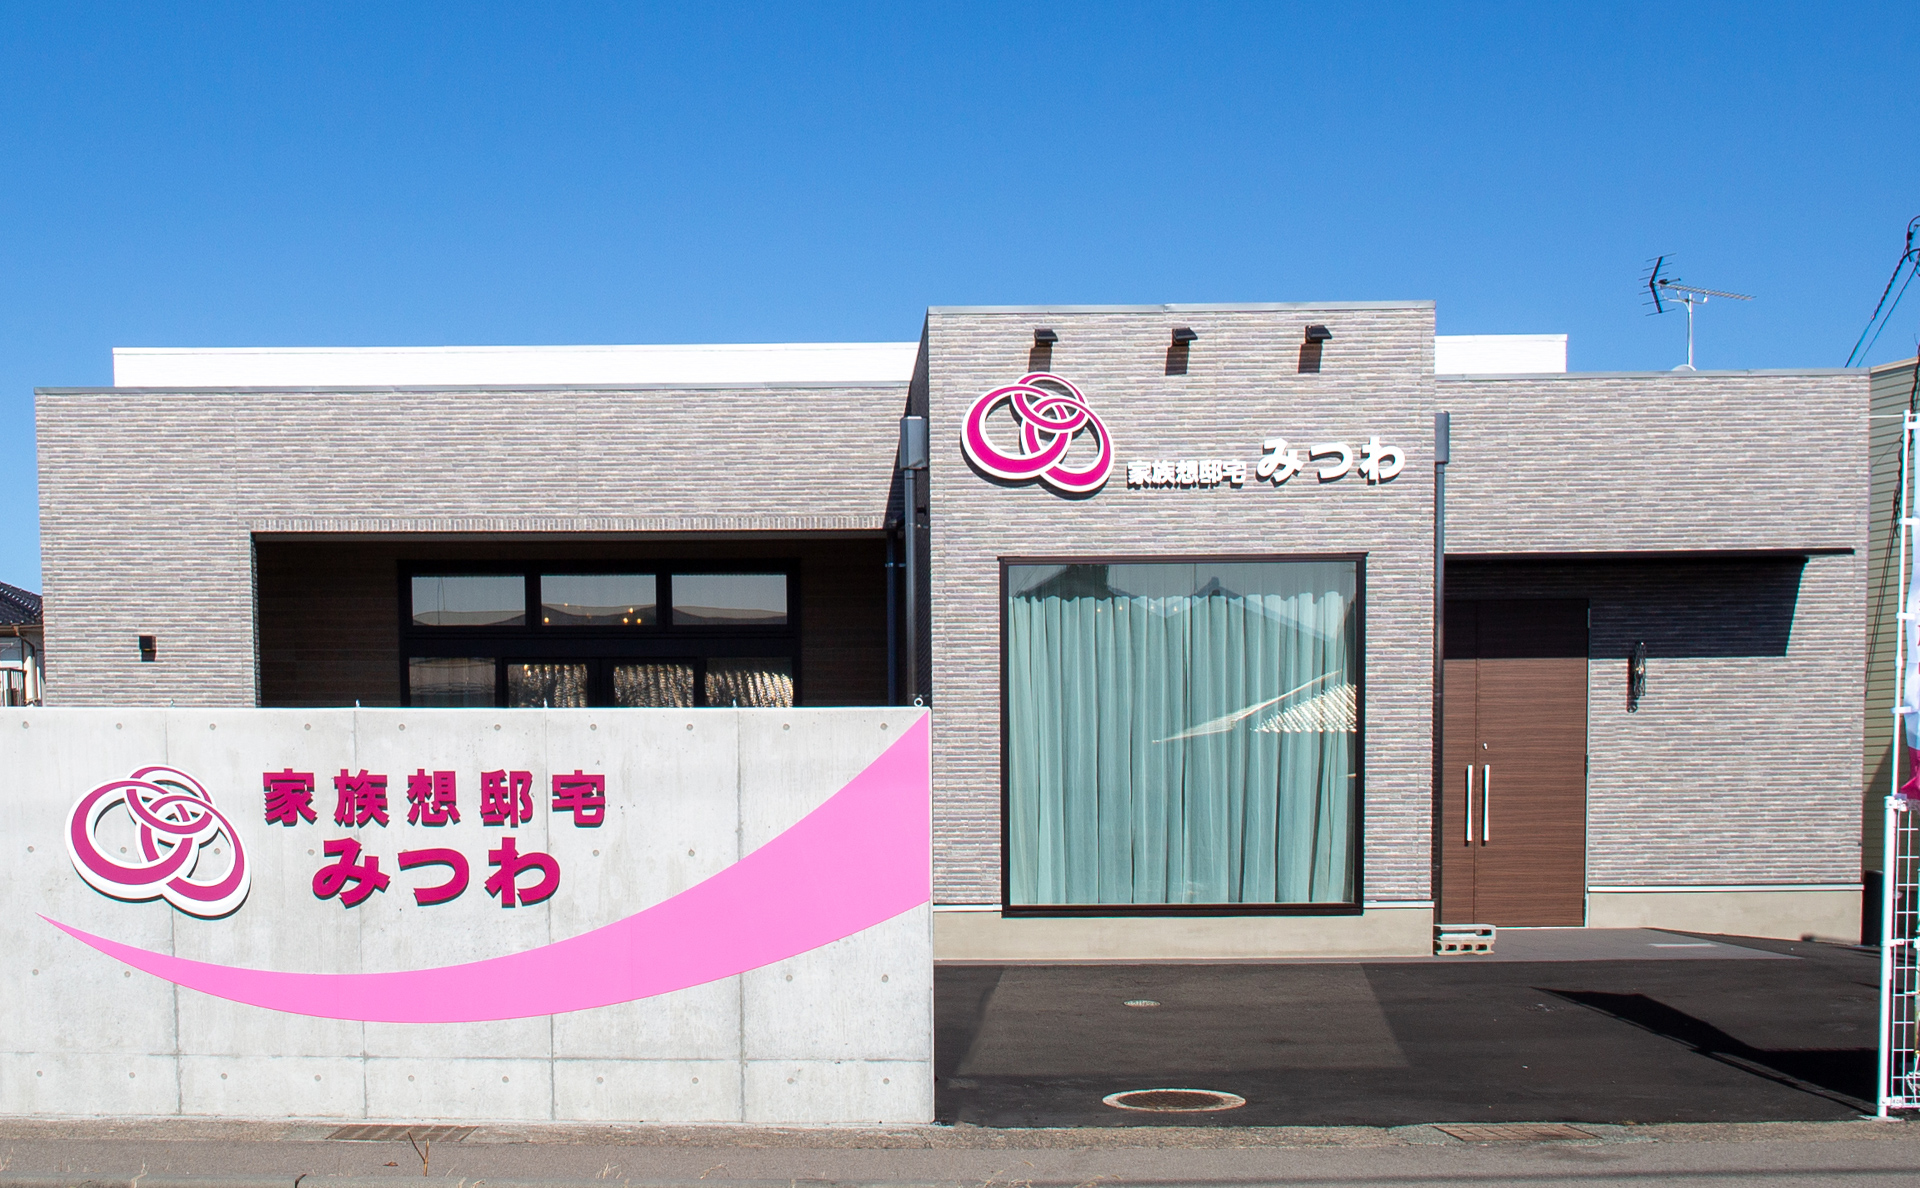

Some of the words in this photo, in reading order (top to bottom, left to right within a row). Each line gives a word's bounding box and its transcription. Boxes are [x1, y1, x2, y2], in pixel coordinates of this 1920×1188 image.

[1127, 459, 1247, 486] 家族想邸宅
[1256, 437, 1406, 484] みつわ
[263, 768, 606, 826] 家族想邸宅
[312, 837, 560, 906] みつわ
